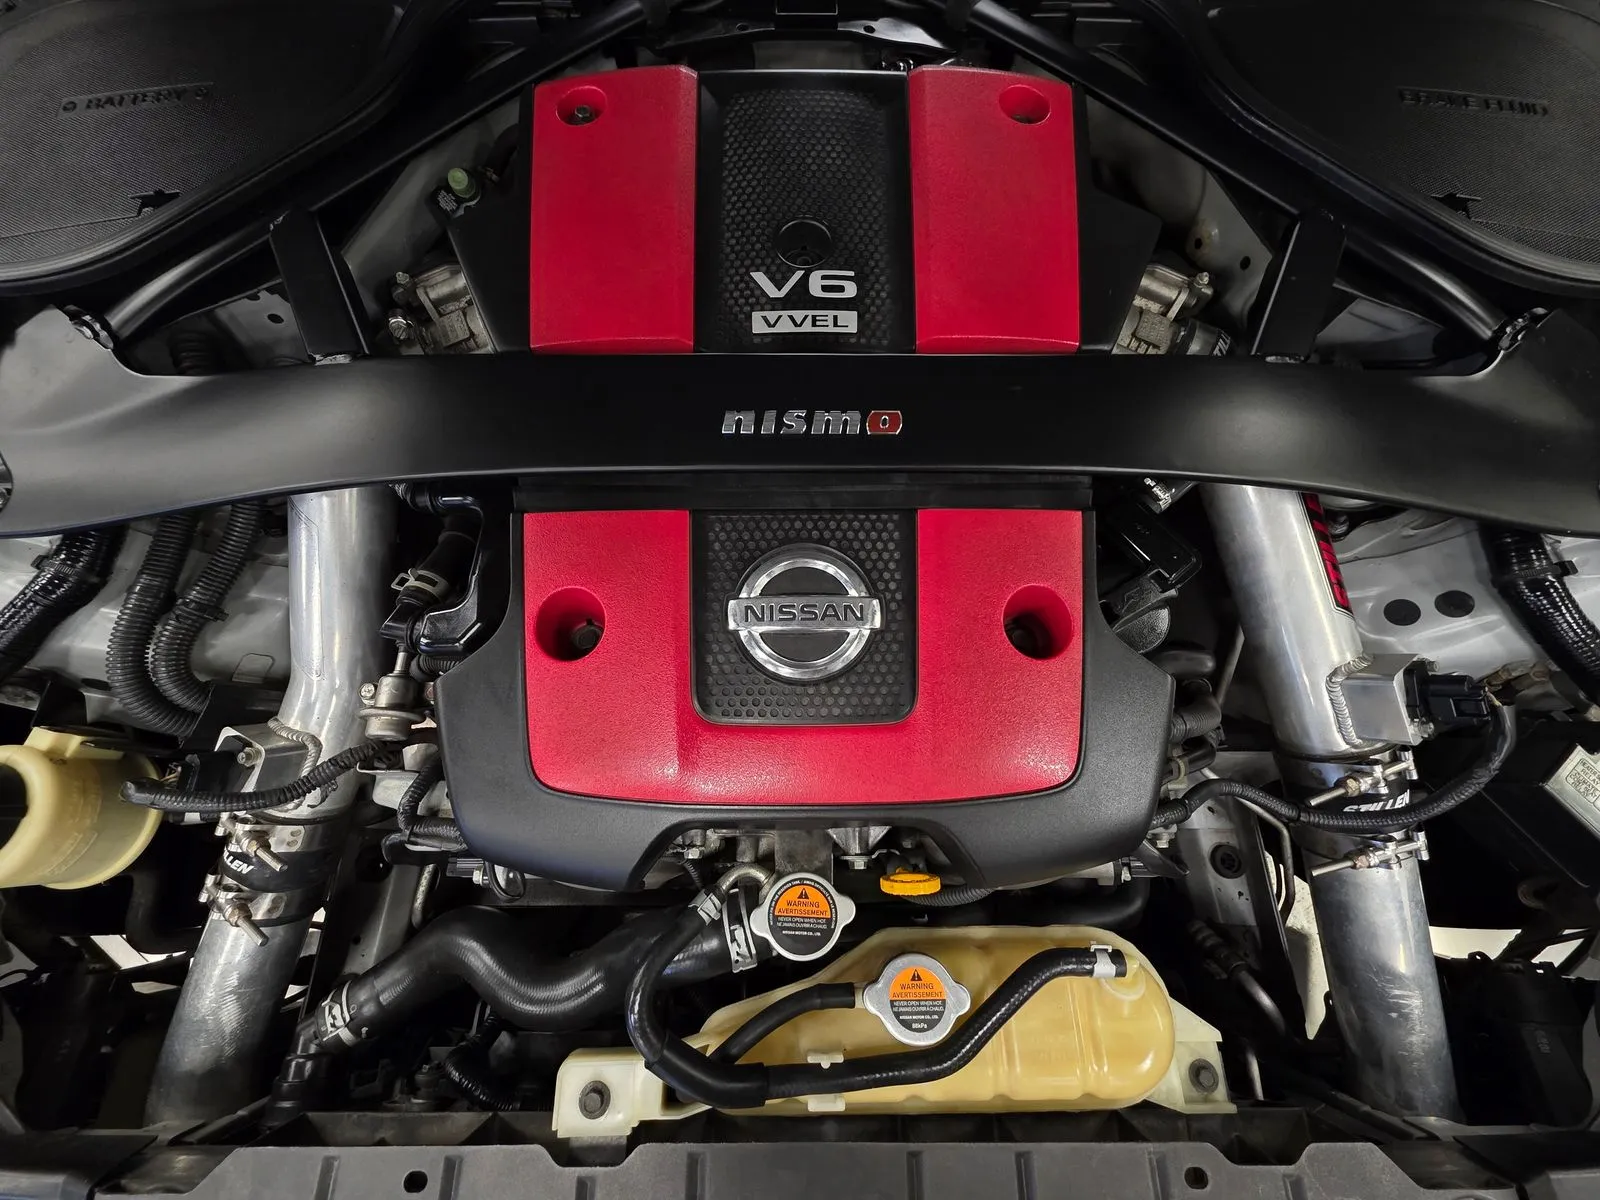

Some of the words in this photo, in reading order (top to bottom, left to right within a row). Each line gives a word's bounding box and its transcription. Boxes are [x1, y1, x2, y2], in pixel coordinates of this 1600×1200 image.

[85, 90, 188, 110] BATTERY
[1399, 90, 1481, 110] BRAKE
[1484, 98, 1549, 116] FLUID
[750, 269, 858, 298] V6
[760, 314, 849, 328] VVEL
[721, 409, 903, 435] nismo
[744, 603, 865, 622] NISSAN
[778, 908, 828, 916] AVERTISSEMENT
[786, 900, 820, 908] WARNING
